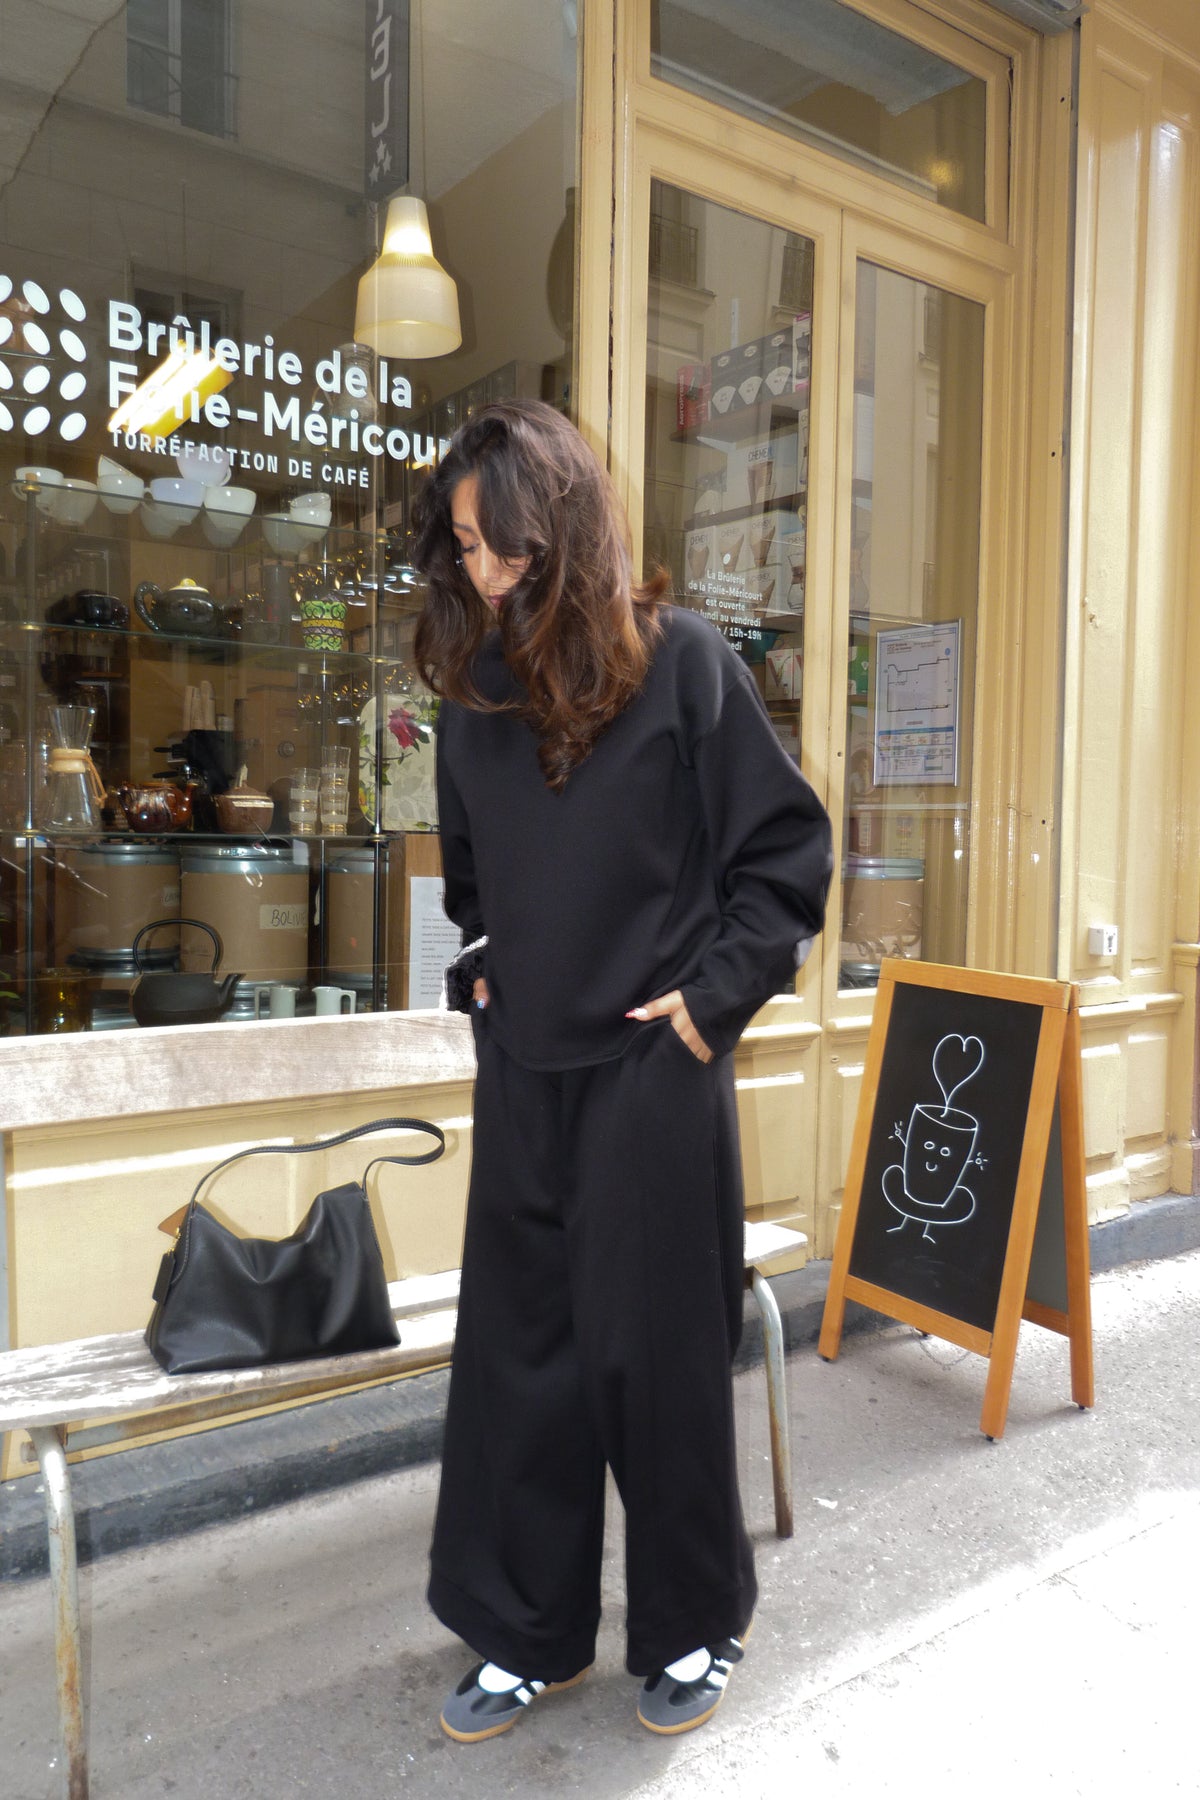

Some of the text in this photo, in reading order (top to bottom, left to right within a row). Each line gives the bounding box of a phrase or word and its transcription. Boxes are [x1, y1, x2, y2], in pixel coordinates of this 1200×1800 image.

[109, 300, 412, 409] Brûlerie de la
[112, 429, 370, 489] TORRÉFACTION DE CAFÉ
[707, 570, 745, 585] La Brûlerie
[688, 581, 763, 601] de la Folie-Méricourt
[705, 597, 745, 611] est ouverte
[700, 608, 718, 621] lundi
[720, 614, 728, 622] au
[730, 615, 761, 627] vendredi
[729, 628, 761, 640] 15h-19h
